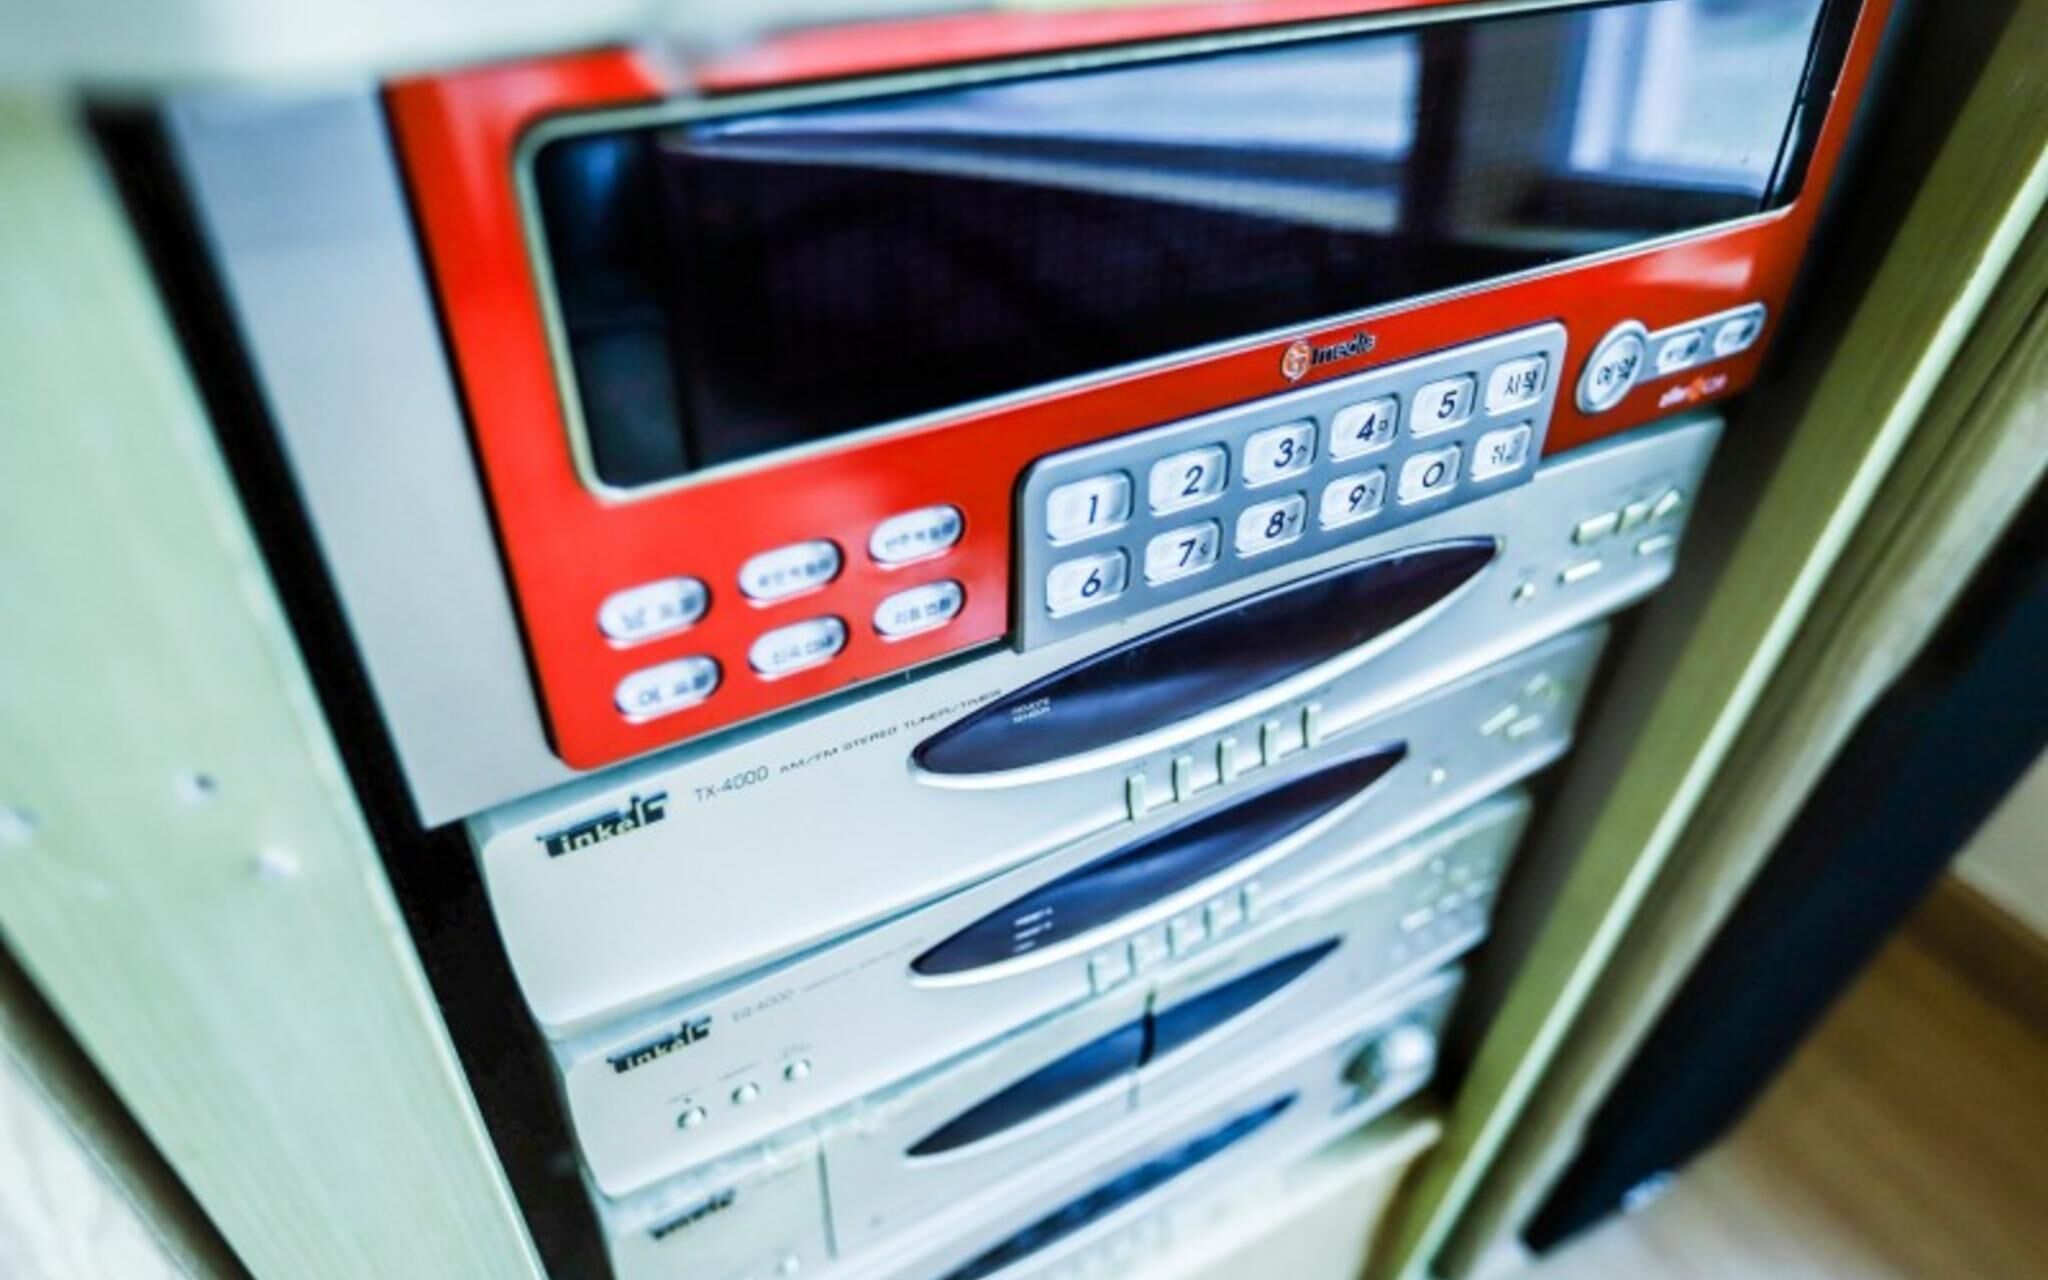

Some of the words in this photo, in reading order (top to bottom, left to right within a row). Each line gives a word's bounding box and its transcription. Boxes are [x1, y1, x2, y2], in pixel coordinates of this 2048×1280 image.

[1437, 390, 1457, 419] 5
[1356, 413, 1376, 442] 4
[1274, 437, 1294, 468] 3
[1181, 465, 1204, 497] 2
[1422, 461, 1446, 488] 0
[1087, 495, 1098, 524] 1
[1348, 484, 1366, 513] 9
[1265, 510, 1285, 539] 8
[1178, 538, 1197, 568] 7
[1080, 568, 1101, 598] 6
[694, 765, 770, 802] TX-4000
[842, 725, 899, 752] STEREO
